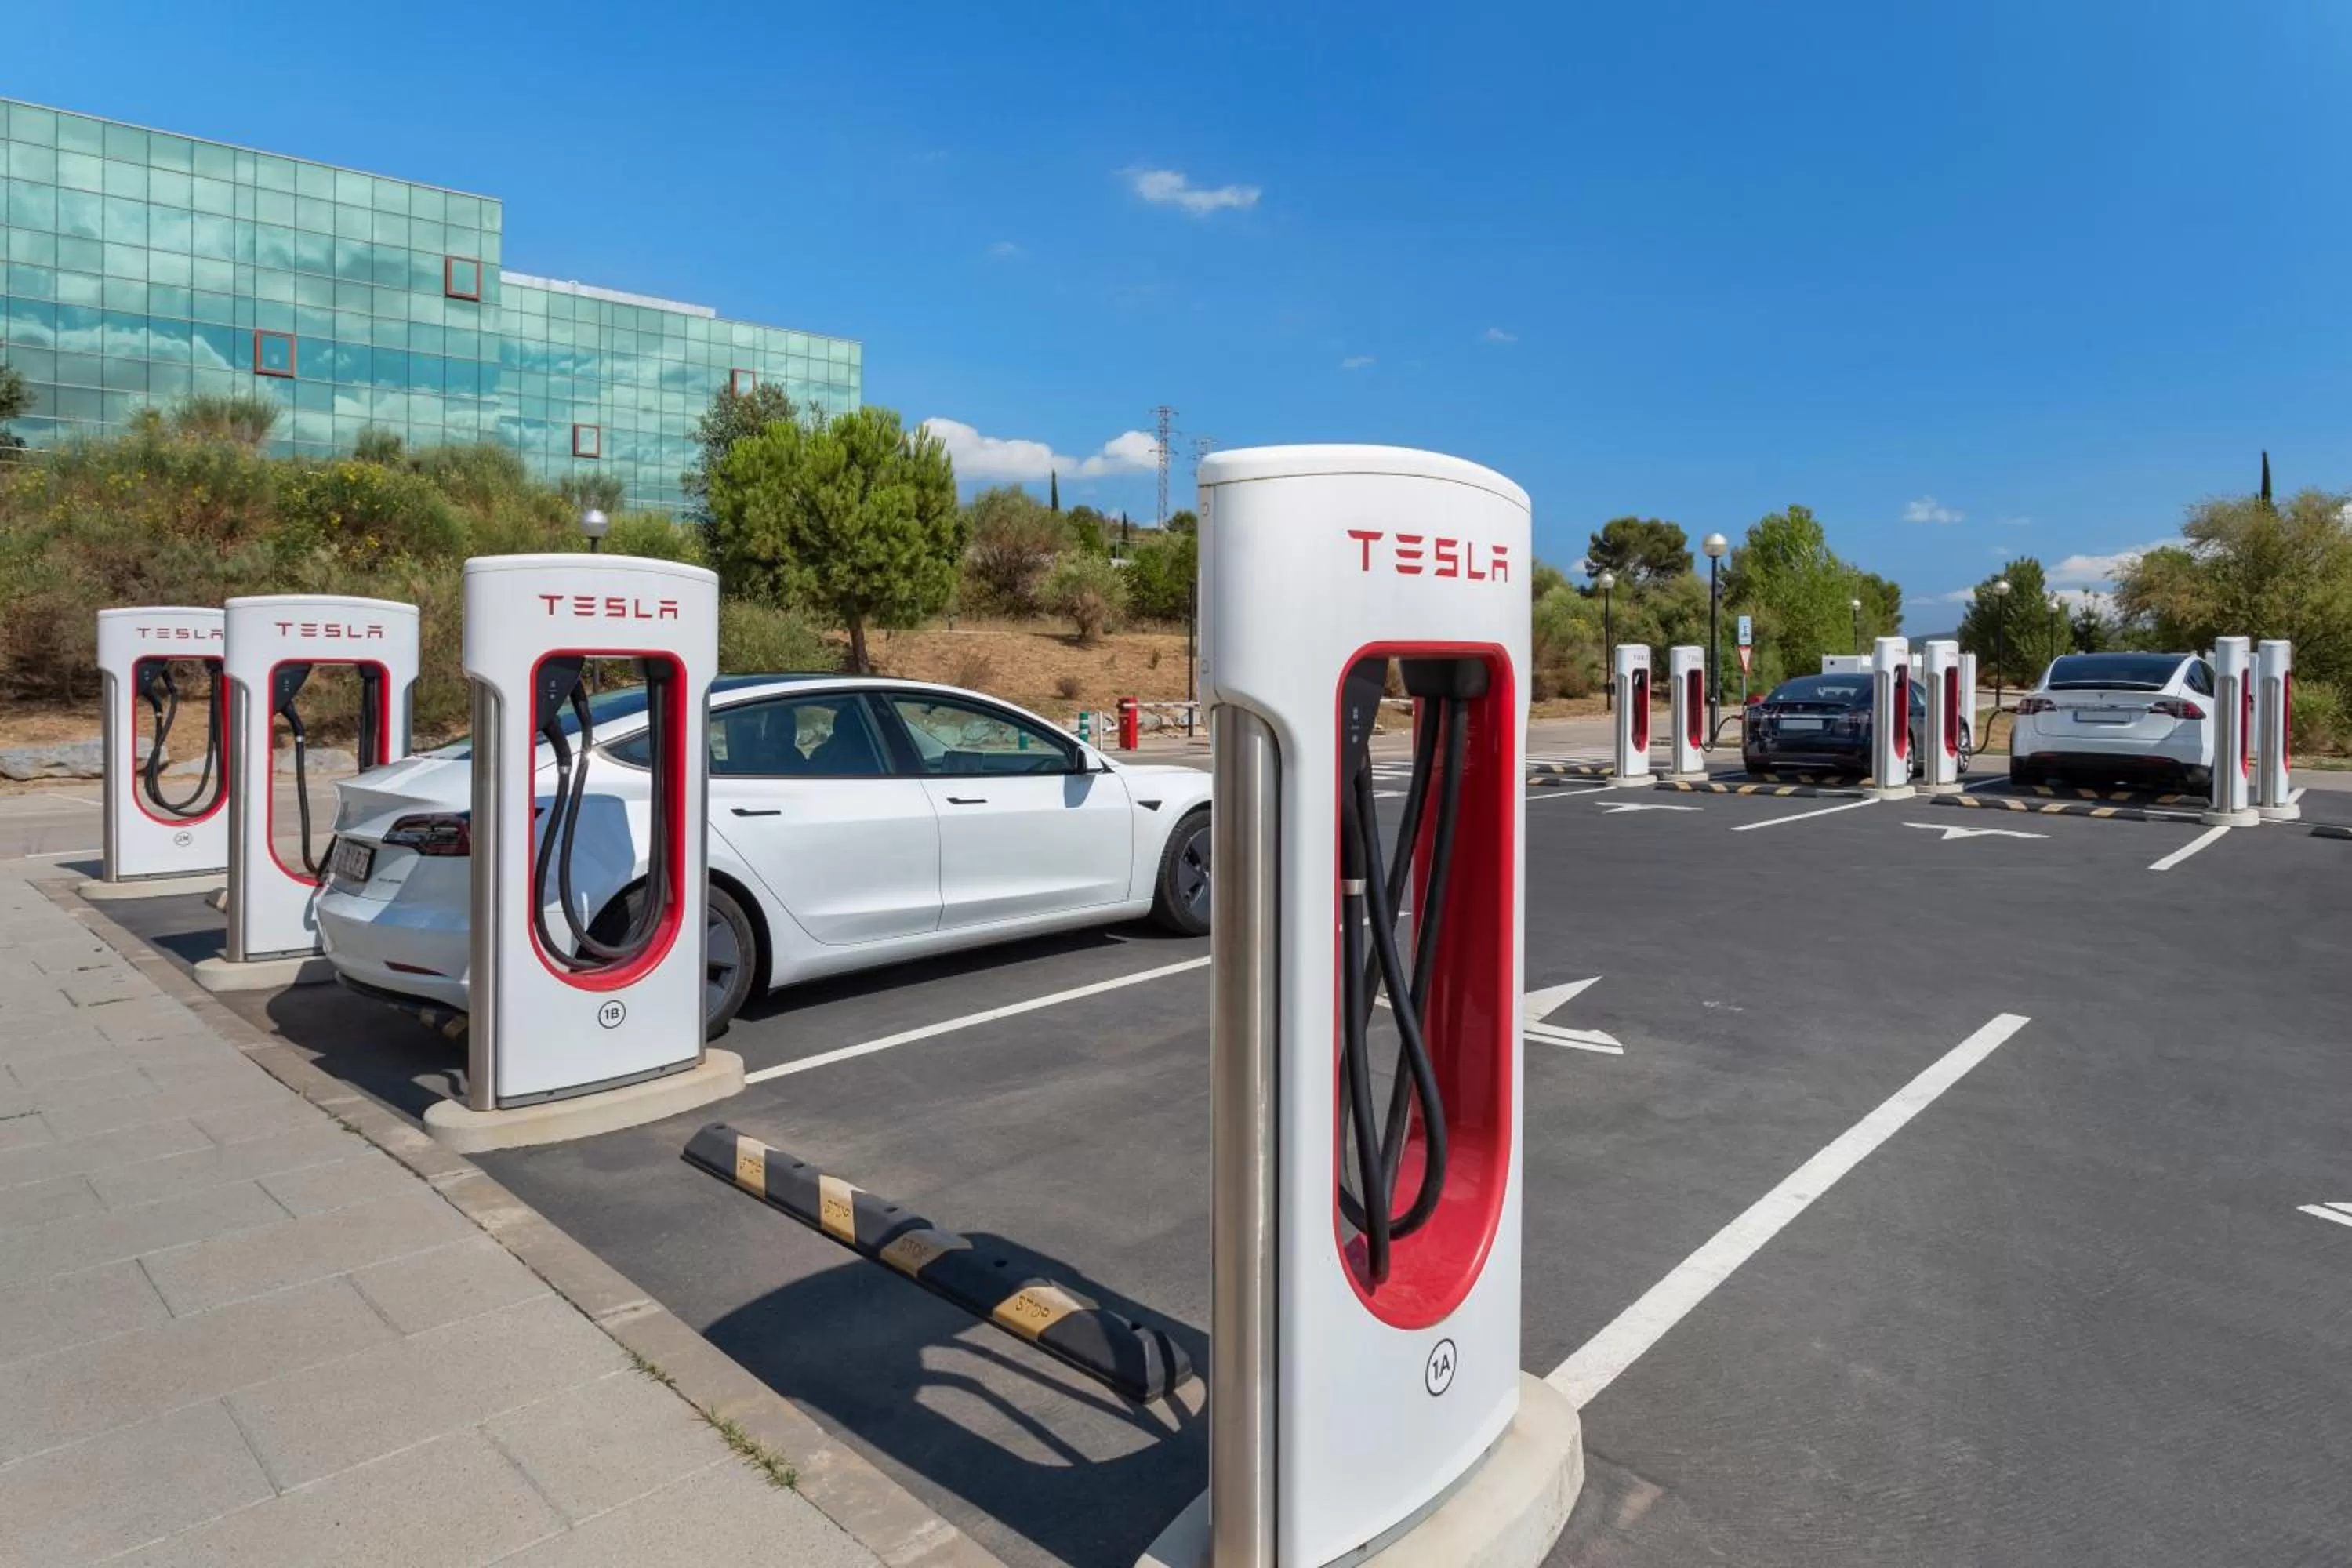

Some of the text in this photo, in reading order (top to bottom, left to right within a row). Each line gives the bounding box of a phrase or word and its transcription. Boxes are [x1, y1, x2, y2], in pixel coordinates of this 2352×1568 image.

[1347, 529, 1508, 583] TESLA
[539, 594, 678, 619] TESLA
[137, 628, 223, 639] TESLA
[275, 622, 383, 639] TESLA
[604, 1007, 620, 1020] 1B
[1432, 1354, 1451, 1381] 1A
